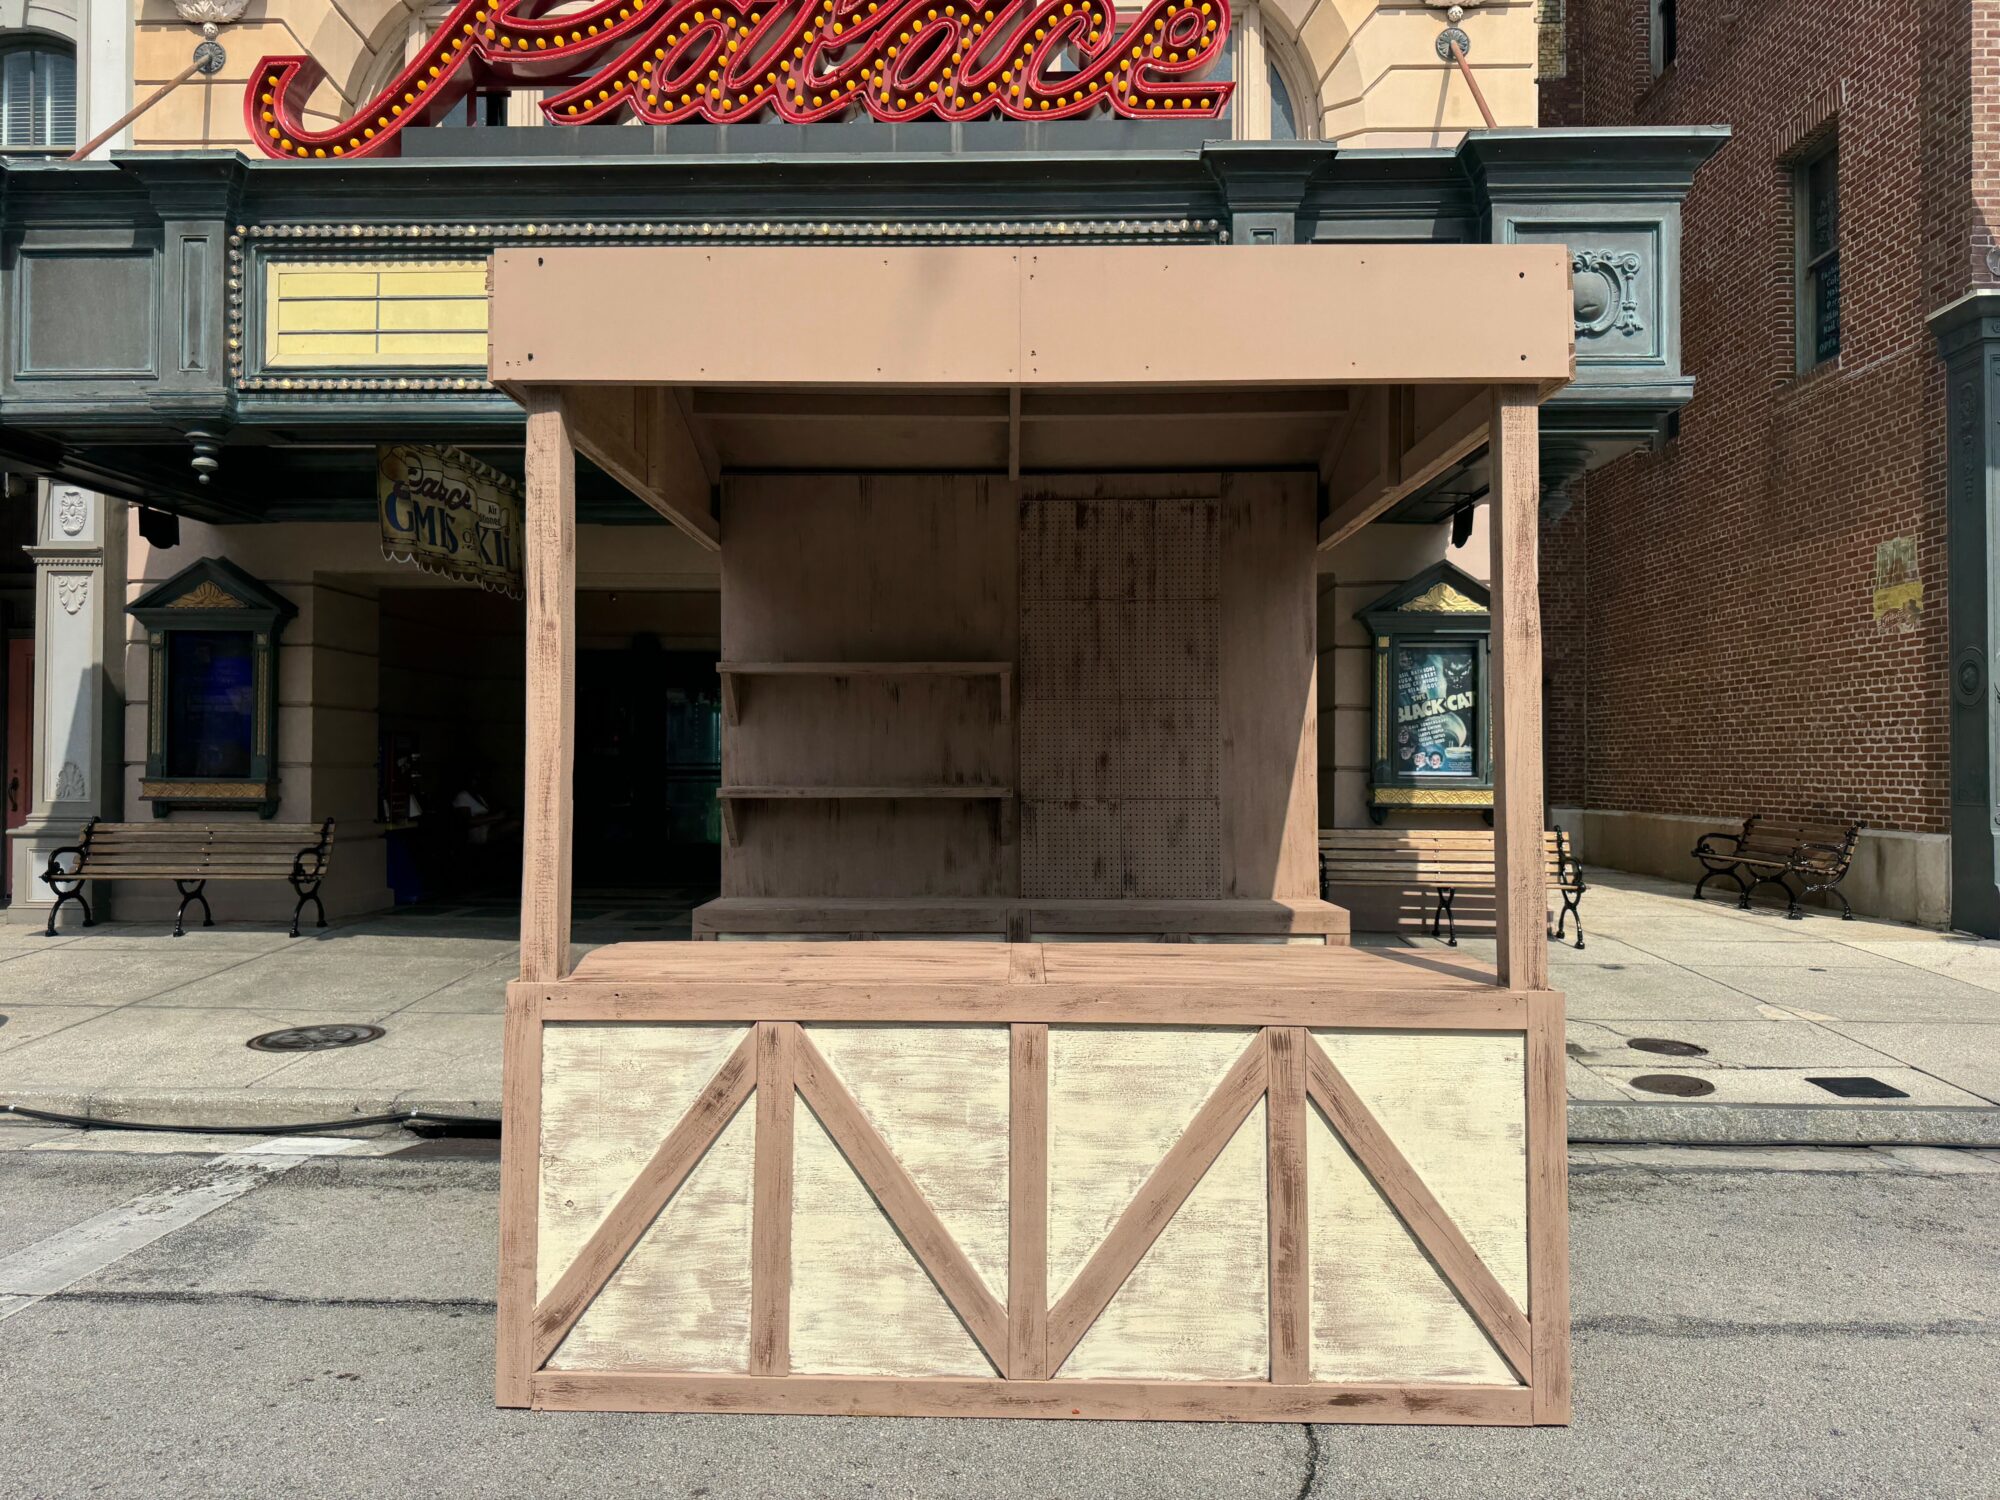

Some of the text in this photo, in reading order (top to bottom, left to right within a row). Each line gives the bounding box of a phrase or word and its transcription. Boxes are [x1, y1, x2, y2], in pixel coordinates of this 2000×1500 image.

[1398, 691, 1473, 723] BLACK CAT
[1411, 693, 1428, 701] THE
